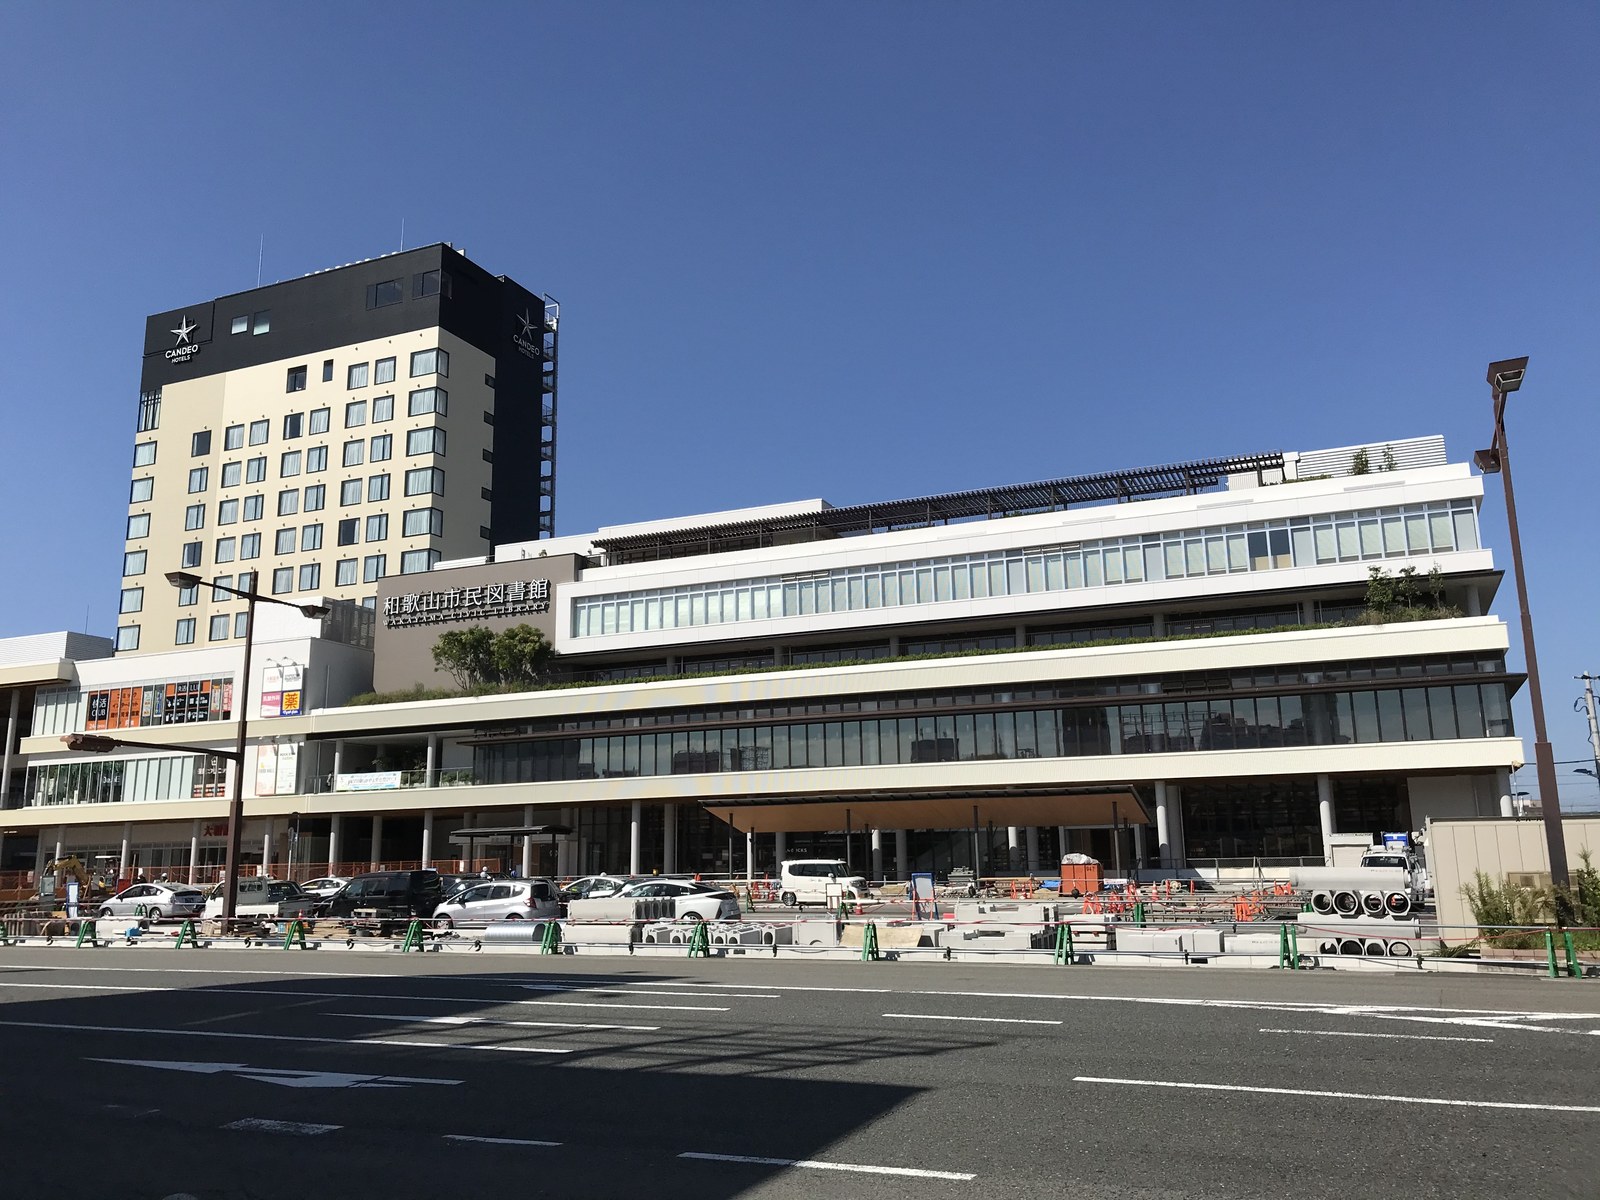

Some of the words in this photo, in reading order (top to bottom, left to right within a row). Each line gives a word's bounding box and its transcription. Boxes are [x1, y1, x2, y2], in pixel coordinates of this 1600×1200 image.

[165, 344, 198, 359] CANDEO
[513, 334, 540, 355] CANDEO
[518, 346, 534, 360] HOTELS
[171, 355, 191, 364] HOTELS
[382, 578, 548, 616] 和歌山市民図書館
[382, 614, 444, 627] WAKAYAMA
[451, 609, 486, 619] CIVIC
[494, 601, 549, 615] LIBRARY
[285, 692, 298, 709] 薬
